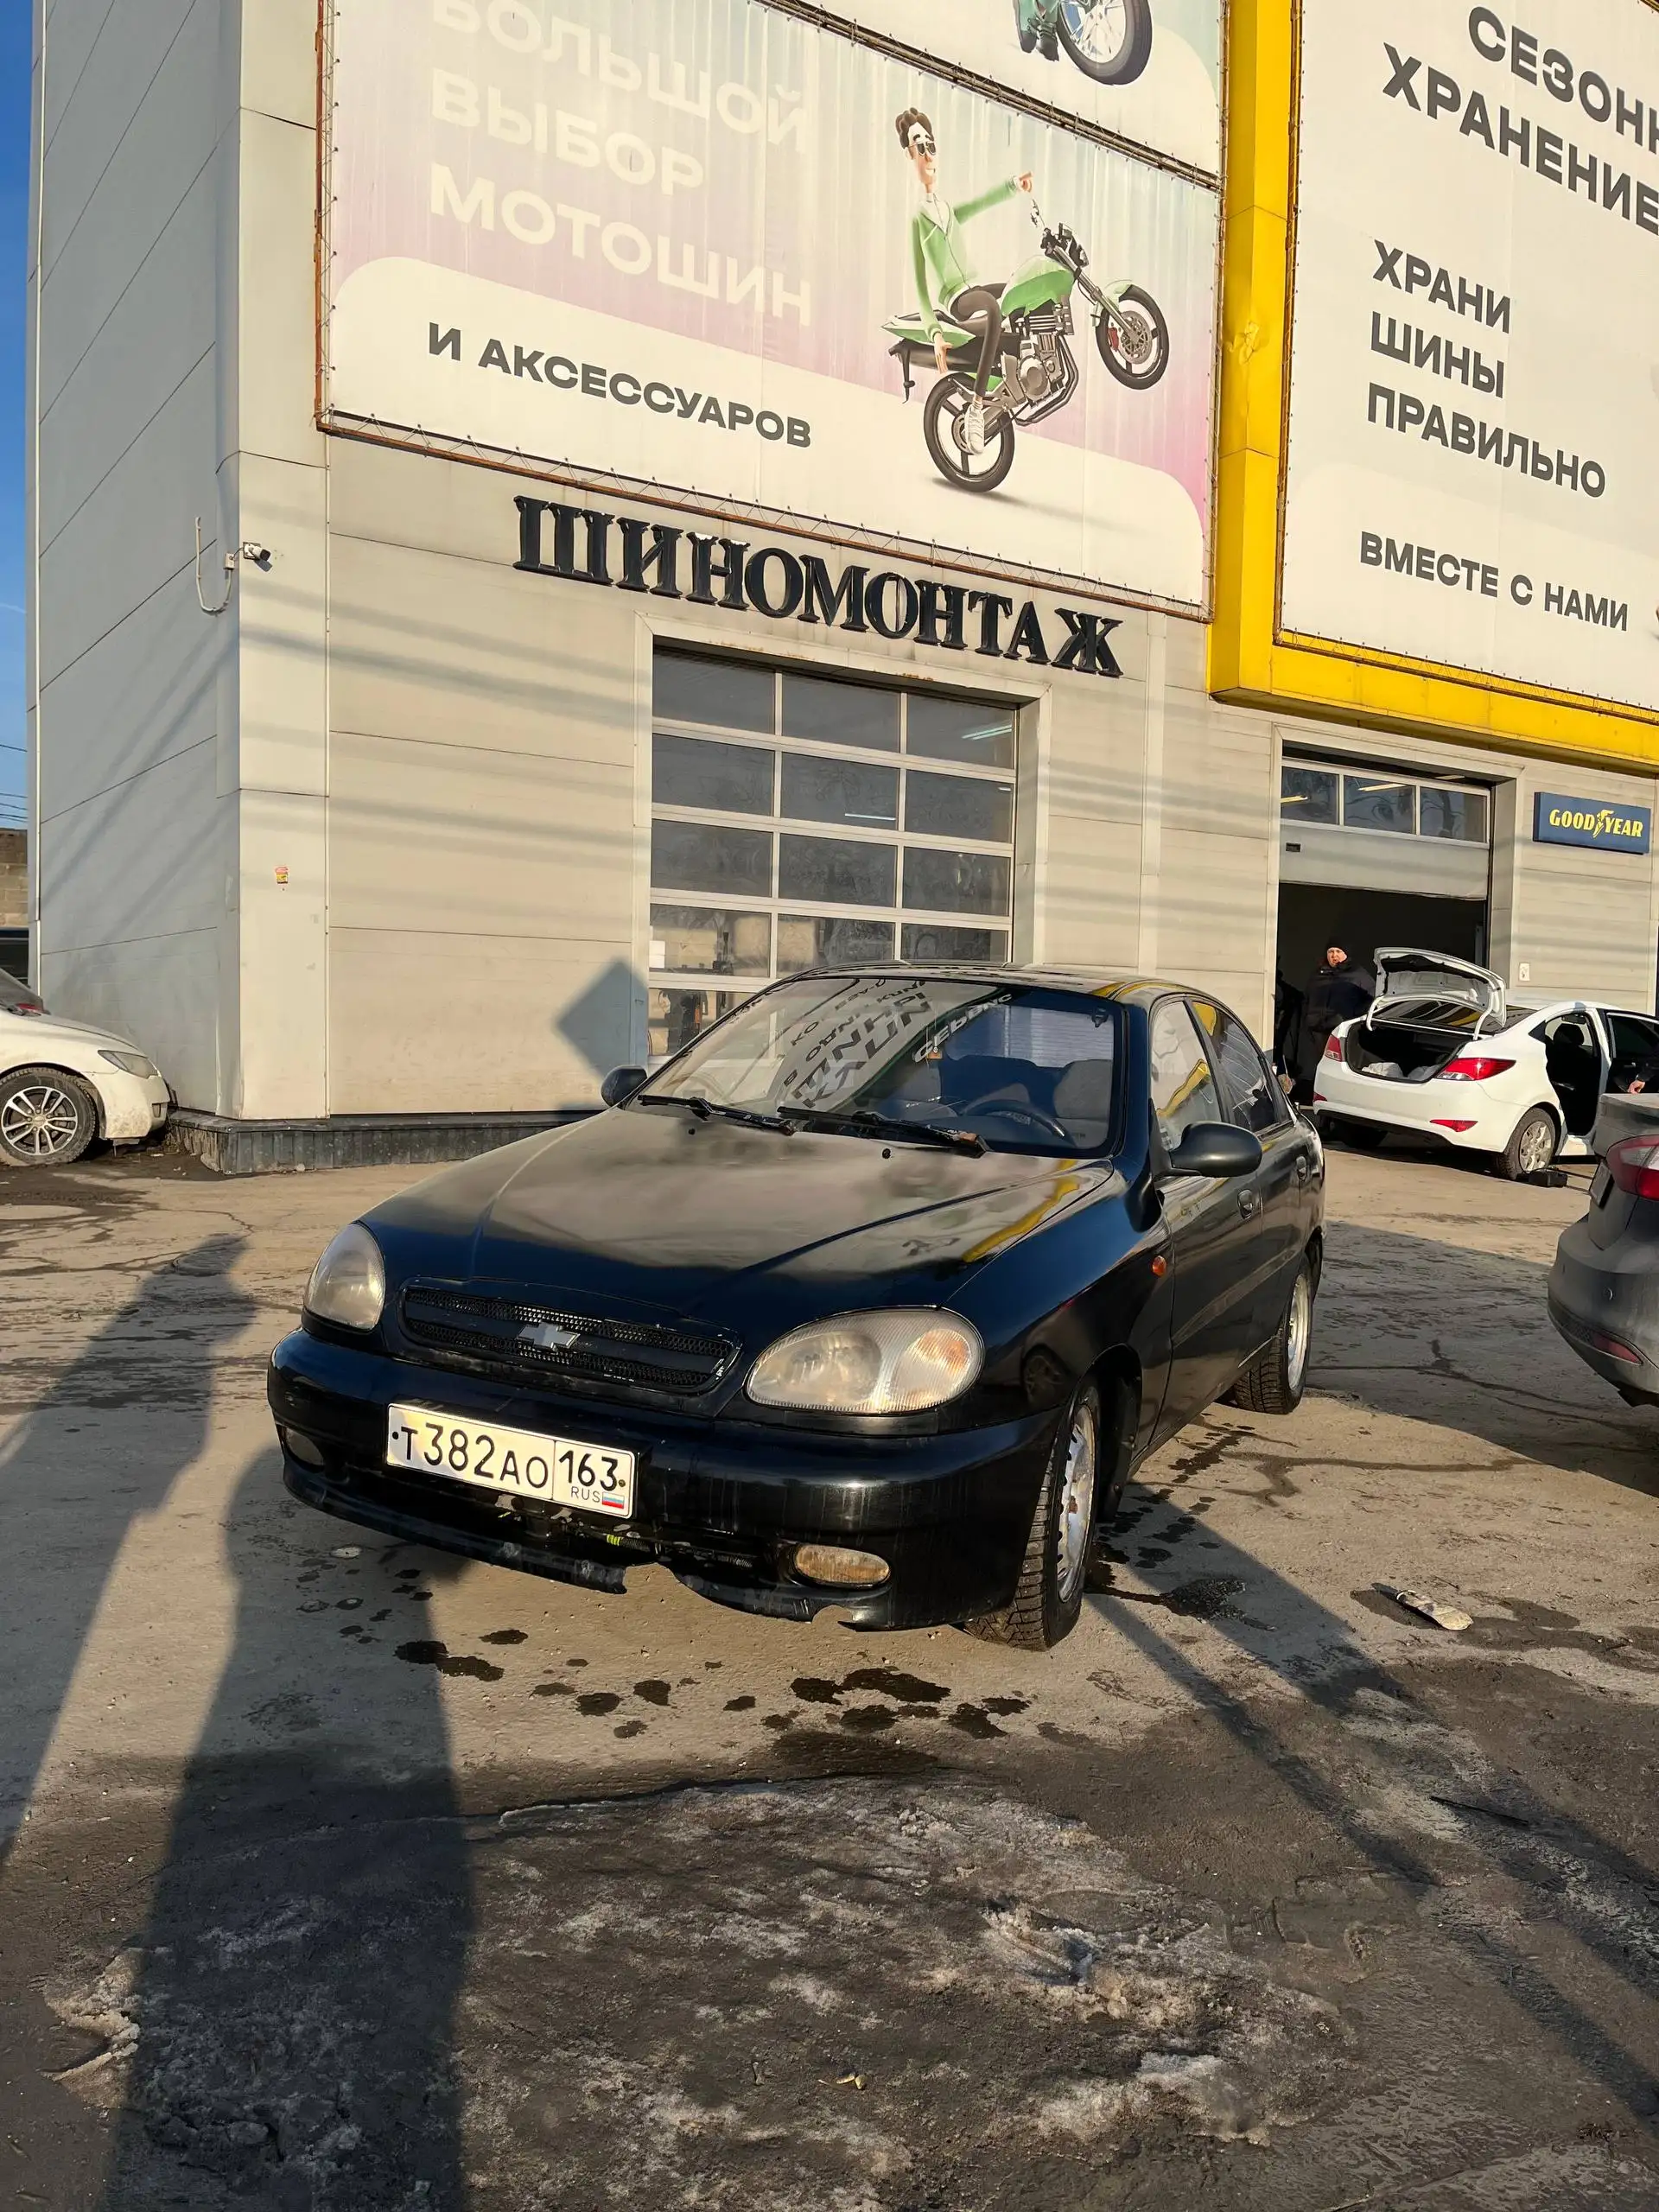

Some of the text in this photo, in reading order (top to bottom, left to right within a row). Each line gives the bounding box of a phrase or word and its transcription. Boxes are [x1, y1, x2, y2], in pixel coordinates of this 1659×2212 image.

[432, 68, 703, 196] ВЫБОР
[1382, 41, 1659, 236] ХРАНЕНИЕ
[431, 162, 811, 327] МОТОШИН
[1373, 239, 1510, 334] ХРАНИ
[429, 321, 811, 448] И АКСЕССУАРОВ
[1371, 311, 1504, 398] ШИНЫ
[1368, 382, 1605, 498] ПРАВИЛЬНО
[512, 494, 1123, 678] ШИНОМОНТАЖ
[1360, 531, 1628, 632] ВМЕСТЕ С НАМИ
[1549, 809, 1643, 837] GOODYEAR
[559, 1450, 618, 1491] 163
[570, 1485, 601, 1503] RUS
